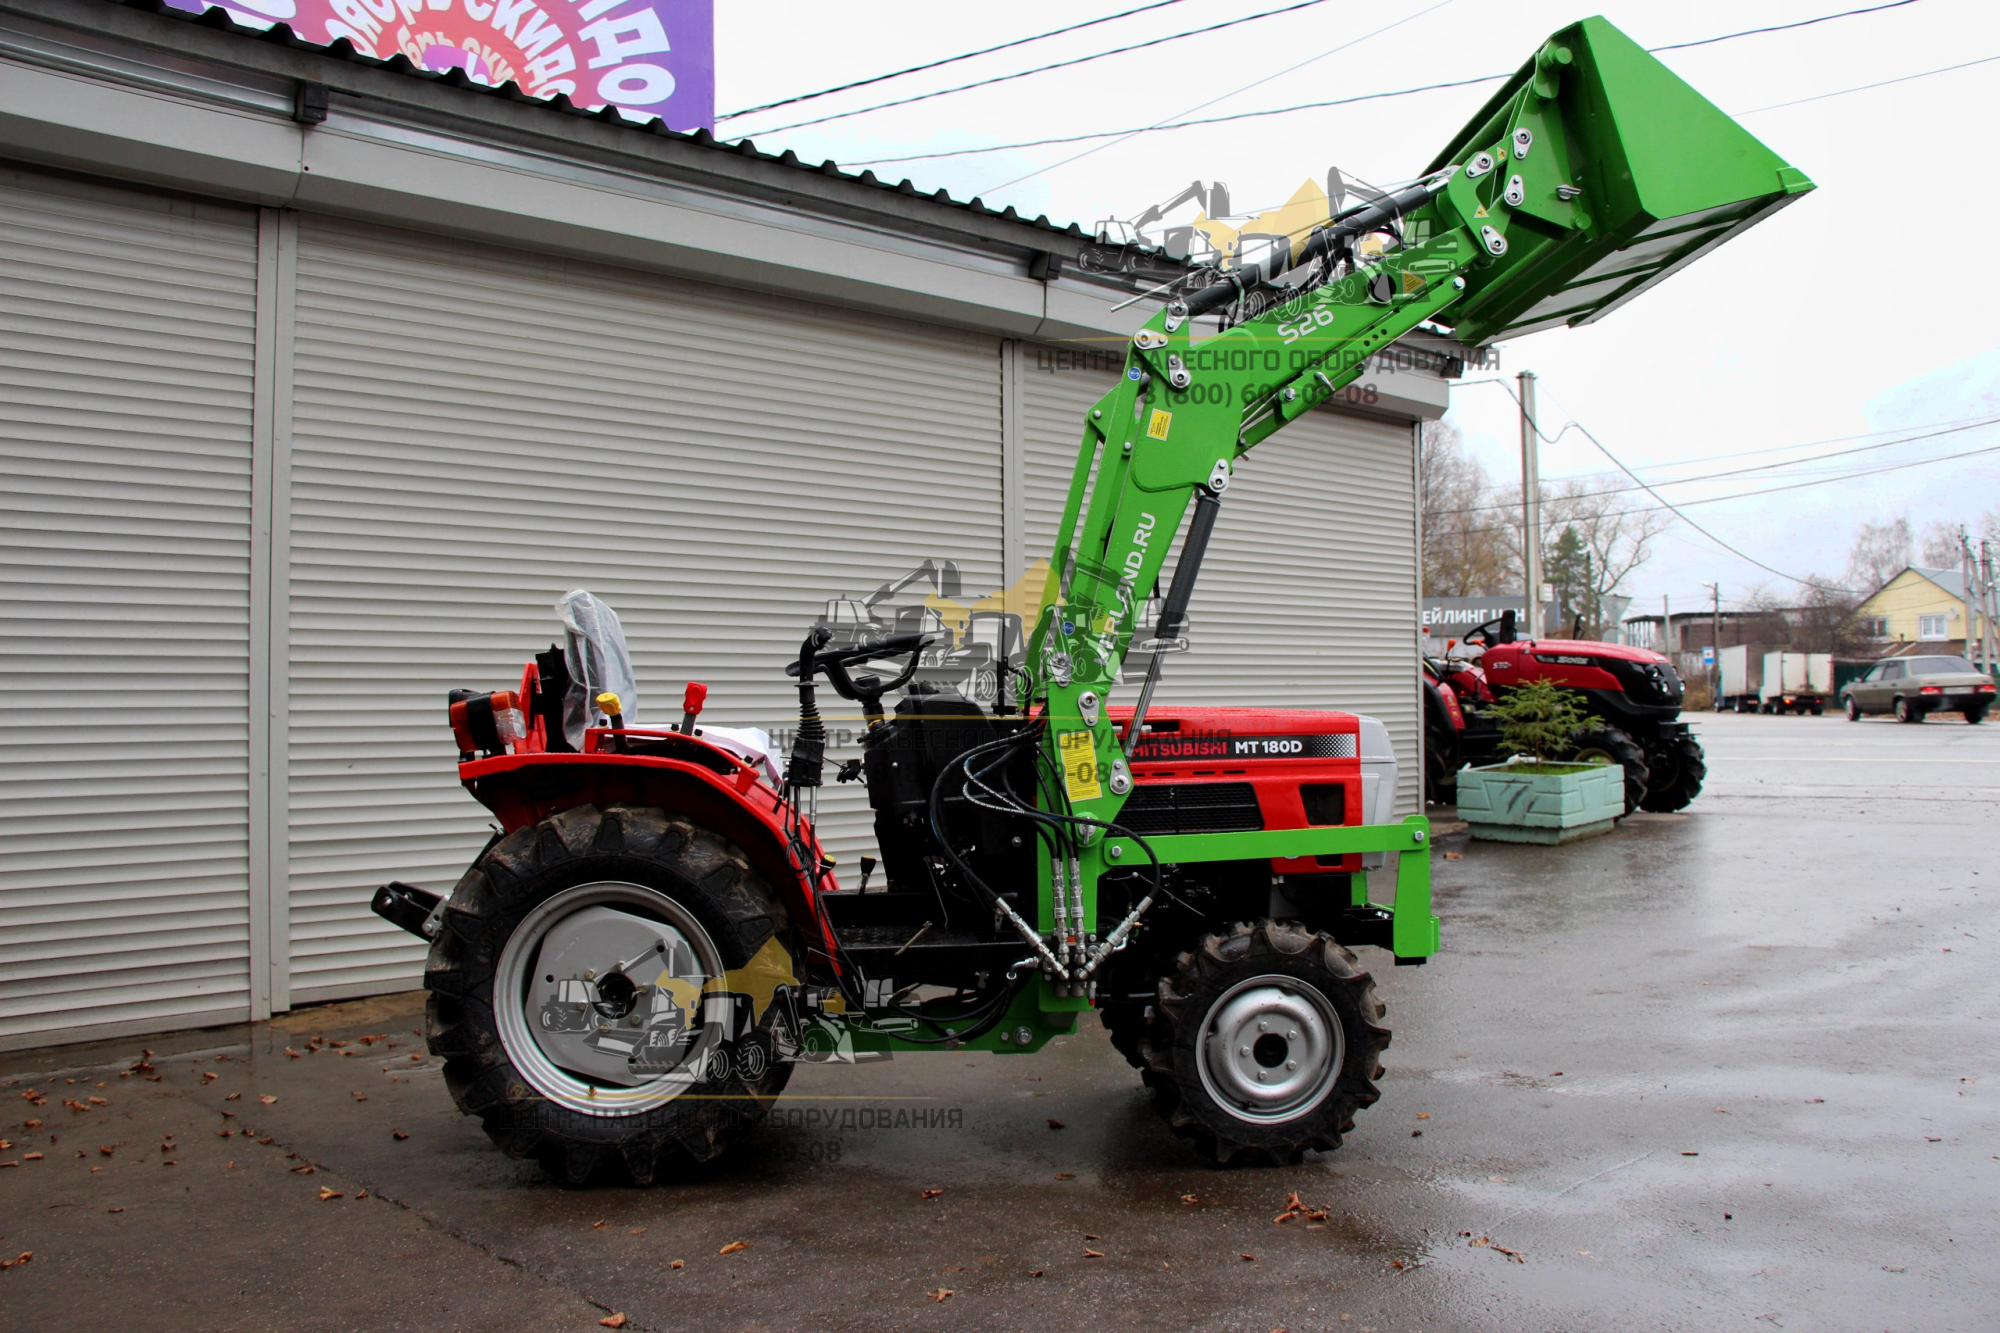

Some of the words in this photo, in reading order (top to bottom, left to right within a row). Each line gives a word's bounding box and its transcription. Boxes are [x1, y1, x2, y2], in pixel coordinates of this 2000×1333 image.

[1277, 304, 1334, 345] S26
[1133, 741, 1228, 757] MITSUBISHI
[1235, 741, 1259, 754] MT
[1262, 740, 1303, 753] 180D
